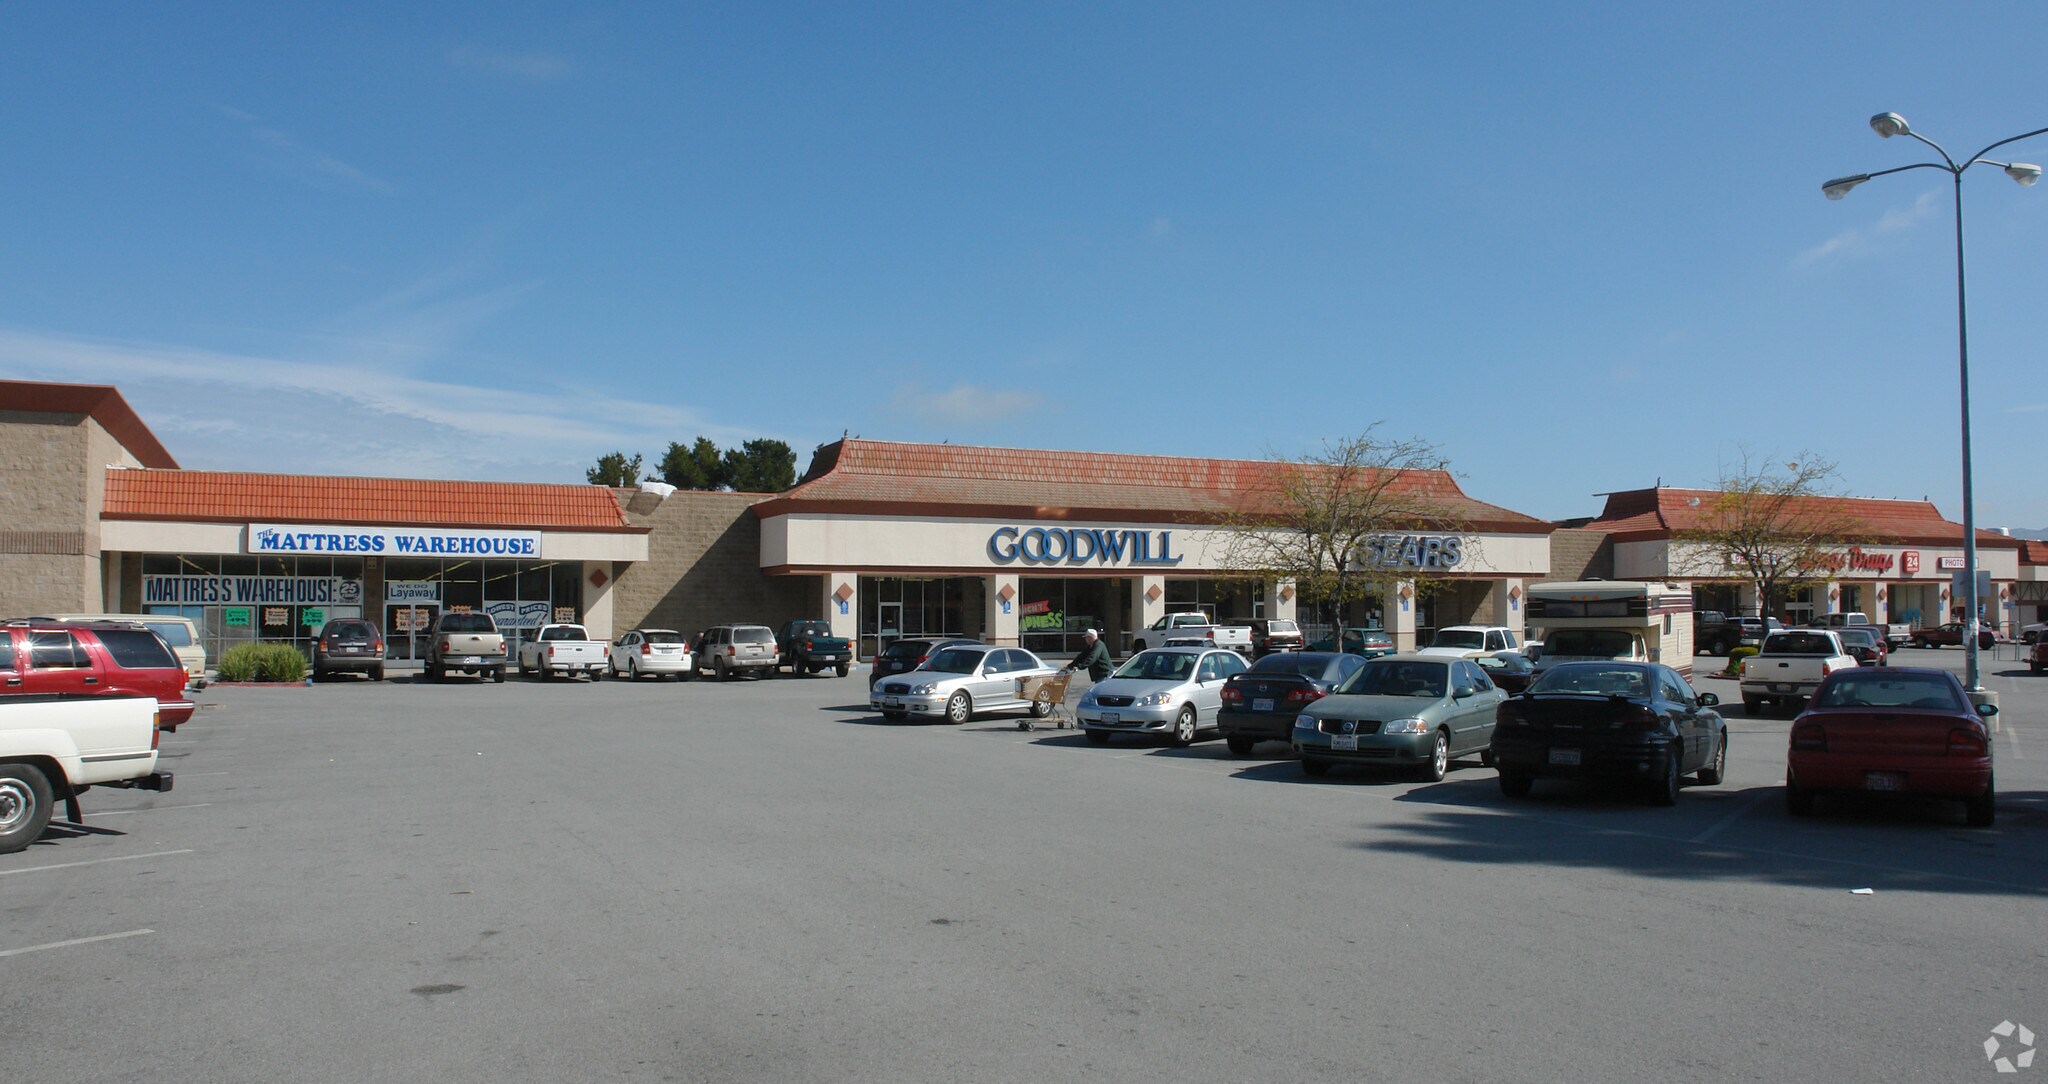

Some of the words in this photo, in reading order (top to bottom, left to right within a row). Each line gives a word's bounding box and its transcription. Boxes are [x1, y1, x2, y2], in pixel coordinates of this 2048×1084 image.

[257, 528, 273, 540] THE
[260, 533, 386, 552] MATTRESS
[394, 535, 535, 555] WAREHOUSE
[991, 526, 1184, 562] GOODWILL
[1360, 535, 1462, 567] SEARS
[1849, 545, 1894, 573] Drugs
[1907, 556, 1918, 567] 24
[1944, 558, 1964, 567] PHOTO
[147, 577, 232, 602] MATTRESS
[236, 578, 337, 603] WAREHOUSE
[340, 582, 357, 594] 25
[390, 587, 435, 600] Layaway
[521, 604, 548, 614] PRICES
